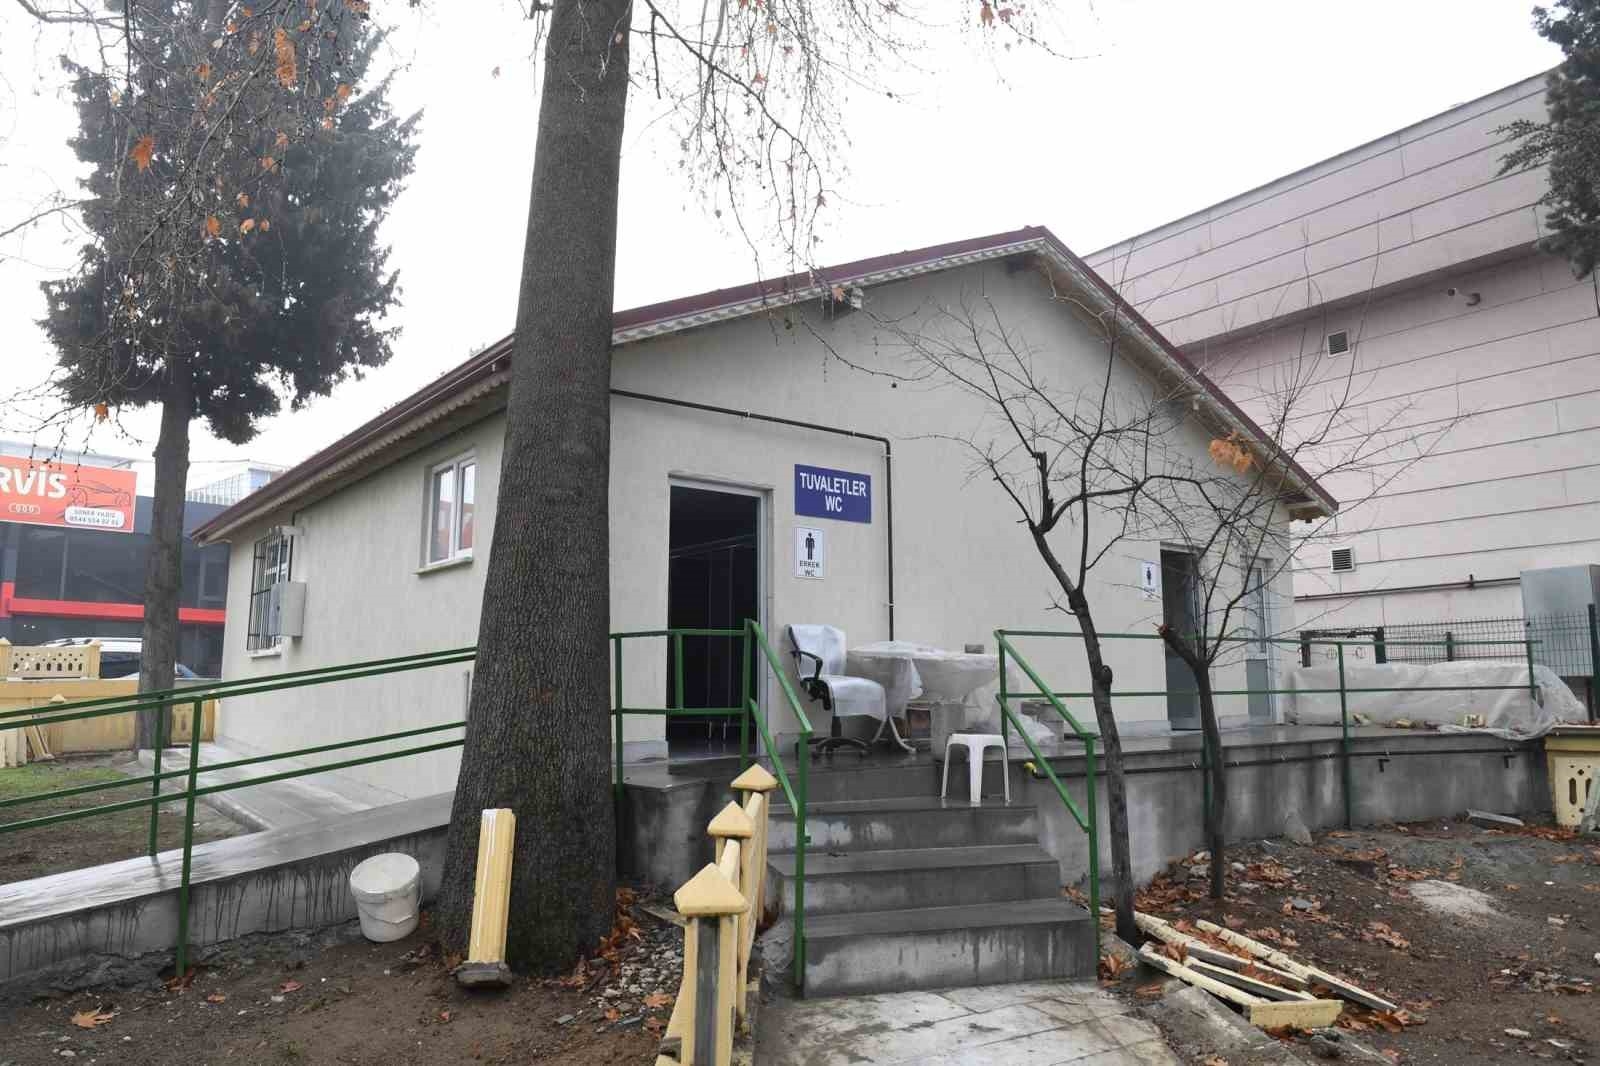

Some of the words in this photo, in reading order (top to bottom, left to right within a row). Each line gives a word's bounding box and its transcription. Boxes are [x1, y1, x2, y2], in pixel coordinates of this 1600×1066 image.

[800, 472, 866, 497] TUVALETLER
[825, 495, 842, 512] WC
[800, 560, 820, 568] ERKEK
[804, 569, 816, 577] WC
